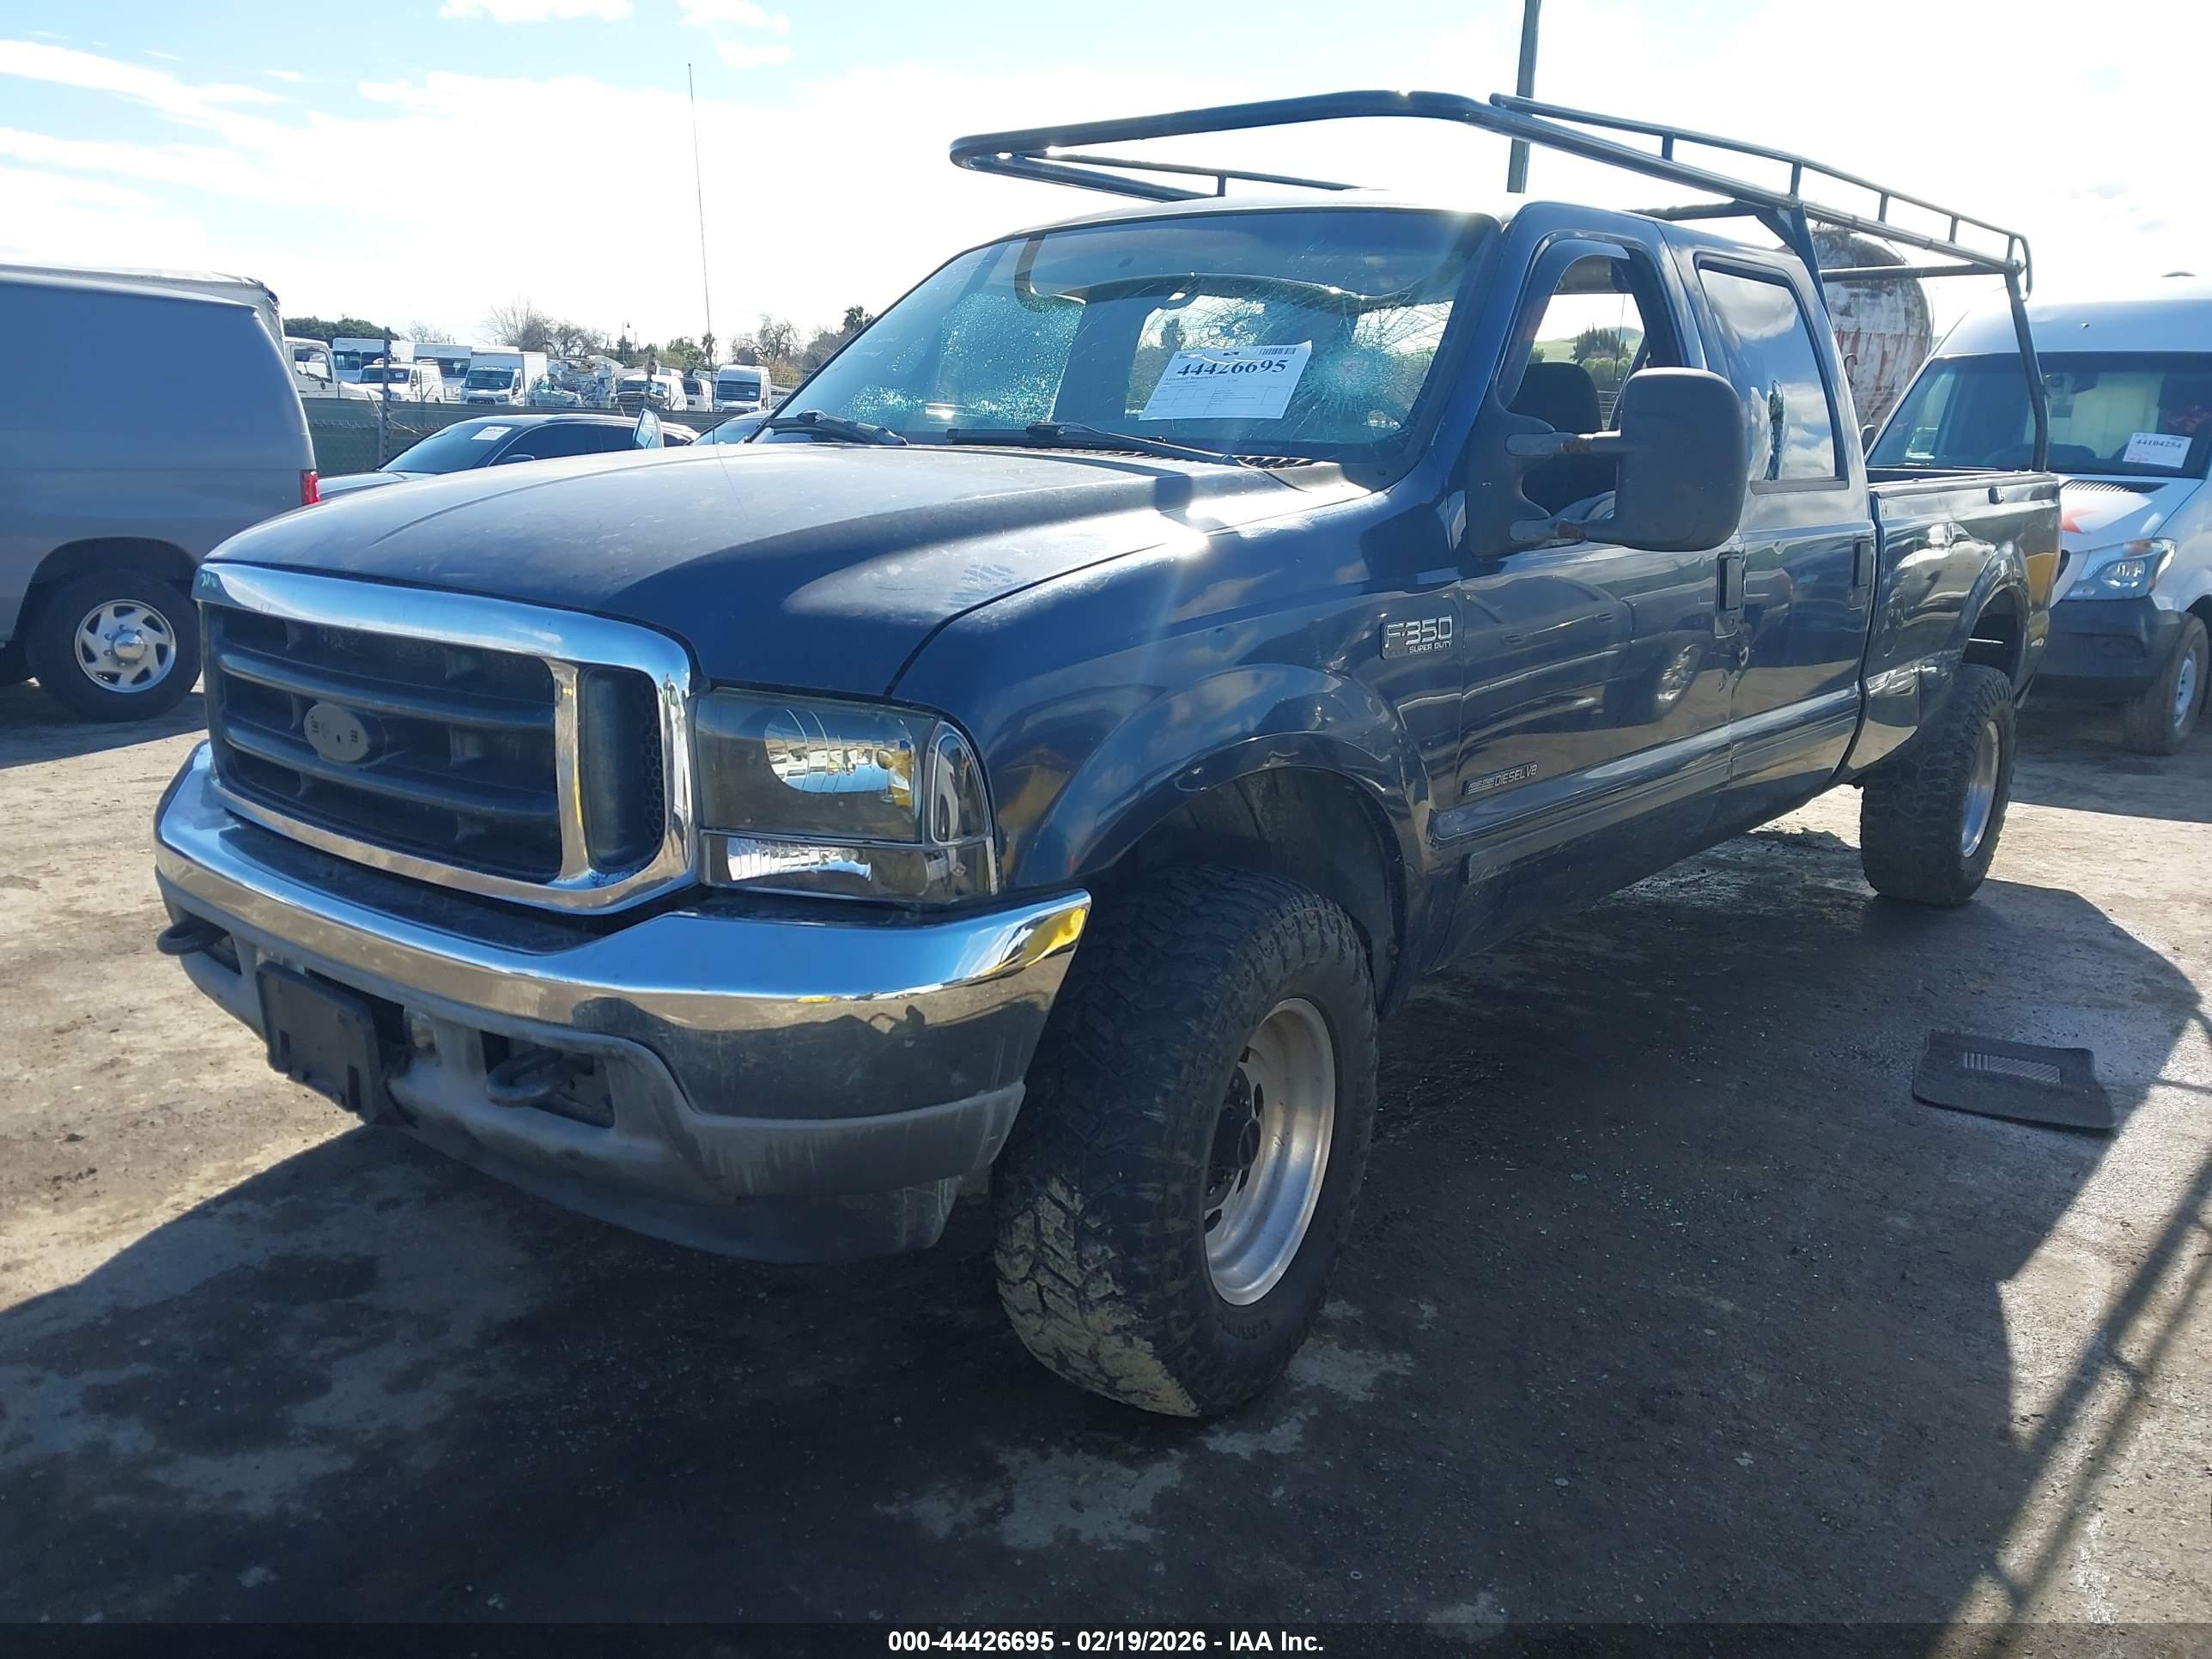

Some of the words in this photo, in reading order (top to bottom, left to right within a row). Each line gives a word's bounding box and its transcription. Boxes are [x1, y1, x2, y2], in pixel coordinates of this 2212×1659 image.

[1176, 359, 1289, 376] 44426695
[1409, 643, 1432, 653] SUPER
[1434, 640, 1453, 649] DUTY
[1494, 769, 1526, 787] DIESEL
[1526, 764, 1538, 777] V8
